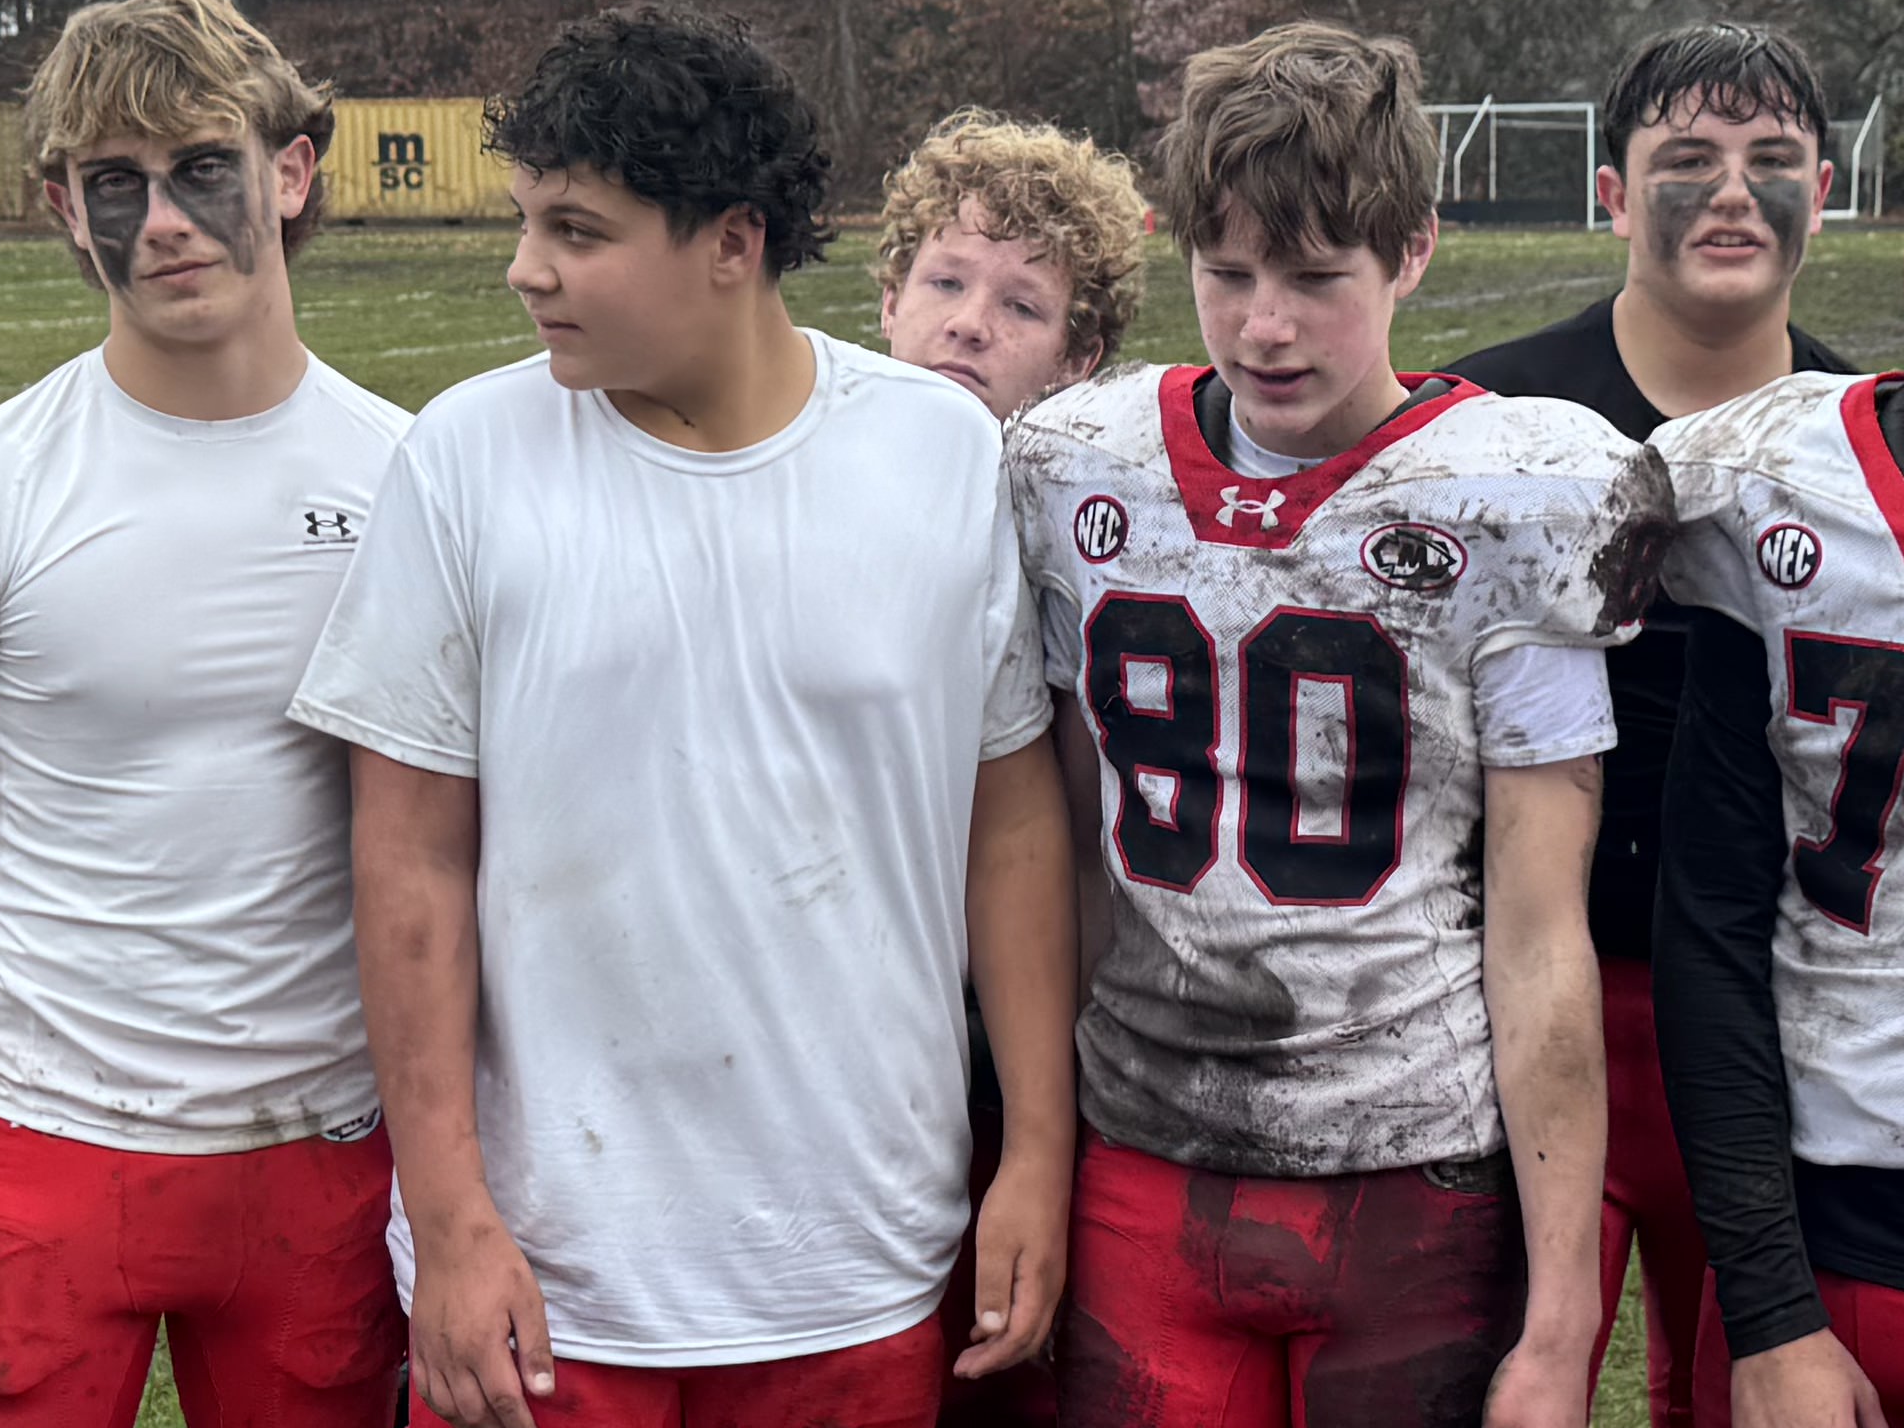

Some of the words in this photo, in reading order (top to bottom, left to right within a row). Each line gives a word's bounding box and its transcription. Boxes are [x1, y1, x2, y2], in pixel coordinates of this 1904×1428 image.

[1077, 500, 1122, 557] NEC
[1761, 528, 1816, 584] NEC
[1083, 589, 1412, 907] 80
